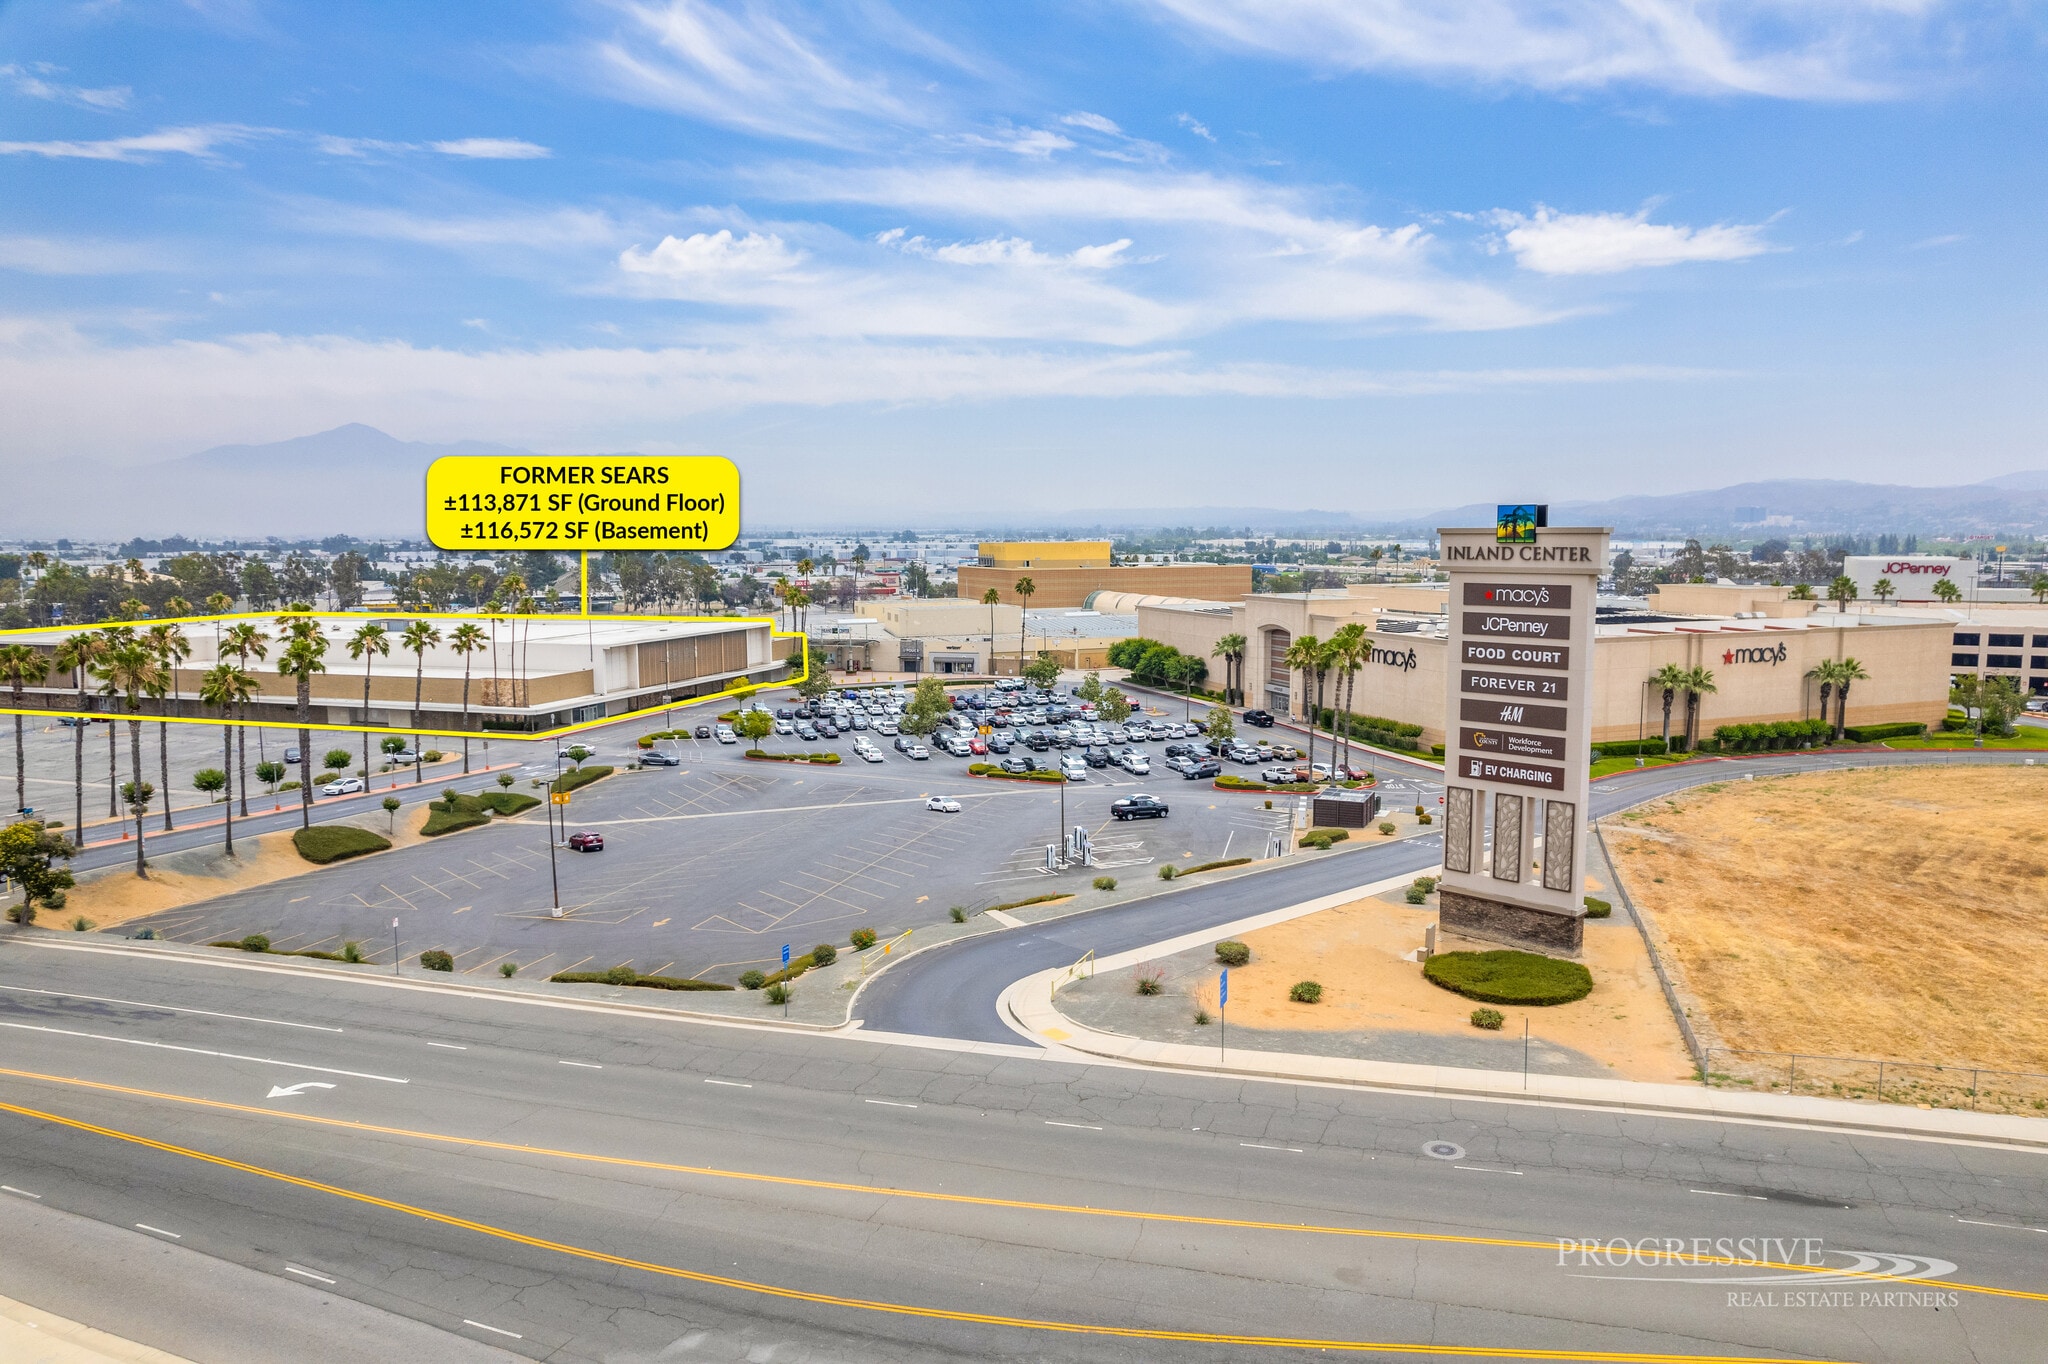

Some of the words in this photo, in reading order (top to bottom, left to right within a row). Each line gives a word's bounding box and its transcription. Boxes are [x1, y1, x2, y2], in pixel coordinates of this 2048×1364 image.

[1446, 545, 1515, 561] INLAND
[1519, 545, 1593, 562] CENTER
[1881, 562, 1951, 576] JCPenney
[1495, 586, 1550, 607] macy's
[1481, 616, 1549, 637] JCPenney
[1372, 648, 1417, 672] macy's
[1467, 647, 1506, 660] FOOD
[1511, 649, 1562, 663] COURT
[1735, 641, 1787, 666] macy's
[1471, 676, 1536, 692] FOREVER
[1542, 682, 1557, 693] 21
[1500, 706, 1524, 723] H&M
[1508, 736, 1542, 747] Workforce
[1508, 743, 1553, 755] Development
[1485, 766, 1499, 777] EV
[1499, 767, 1553, 783] CHARGING
